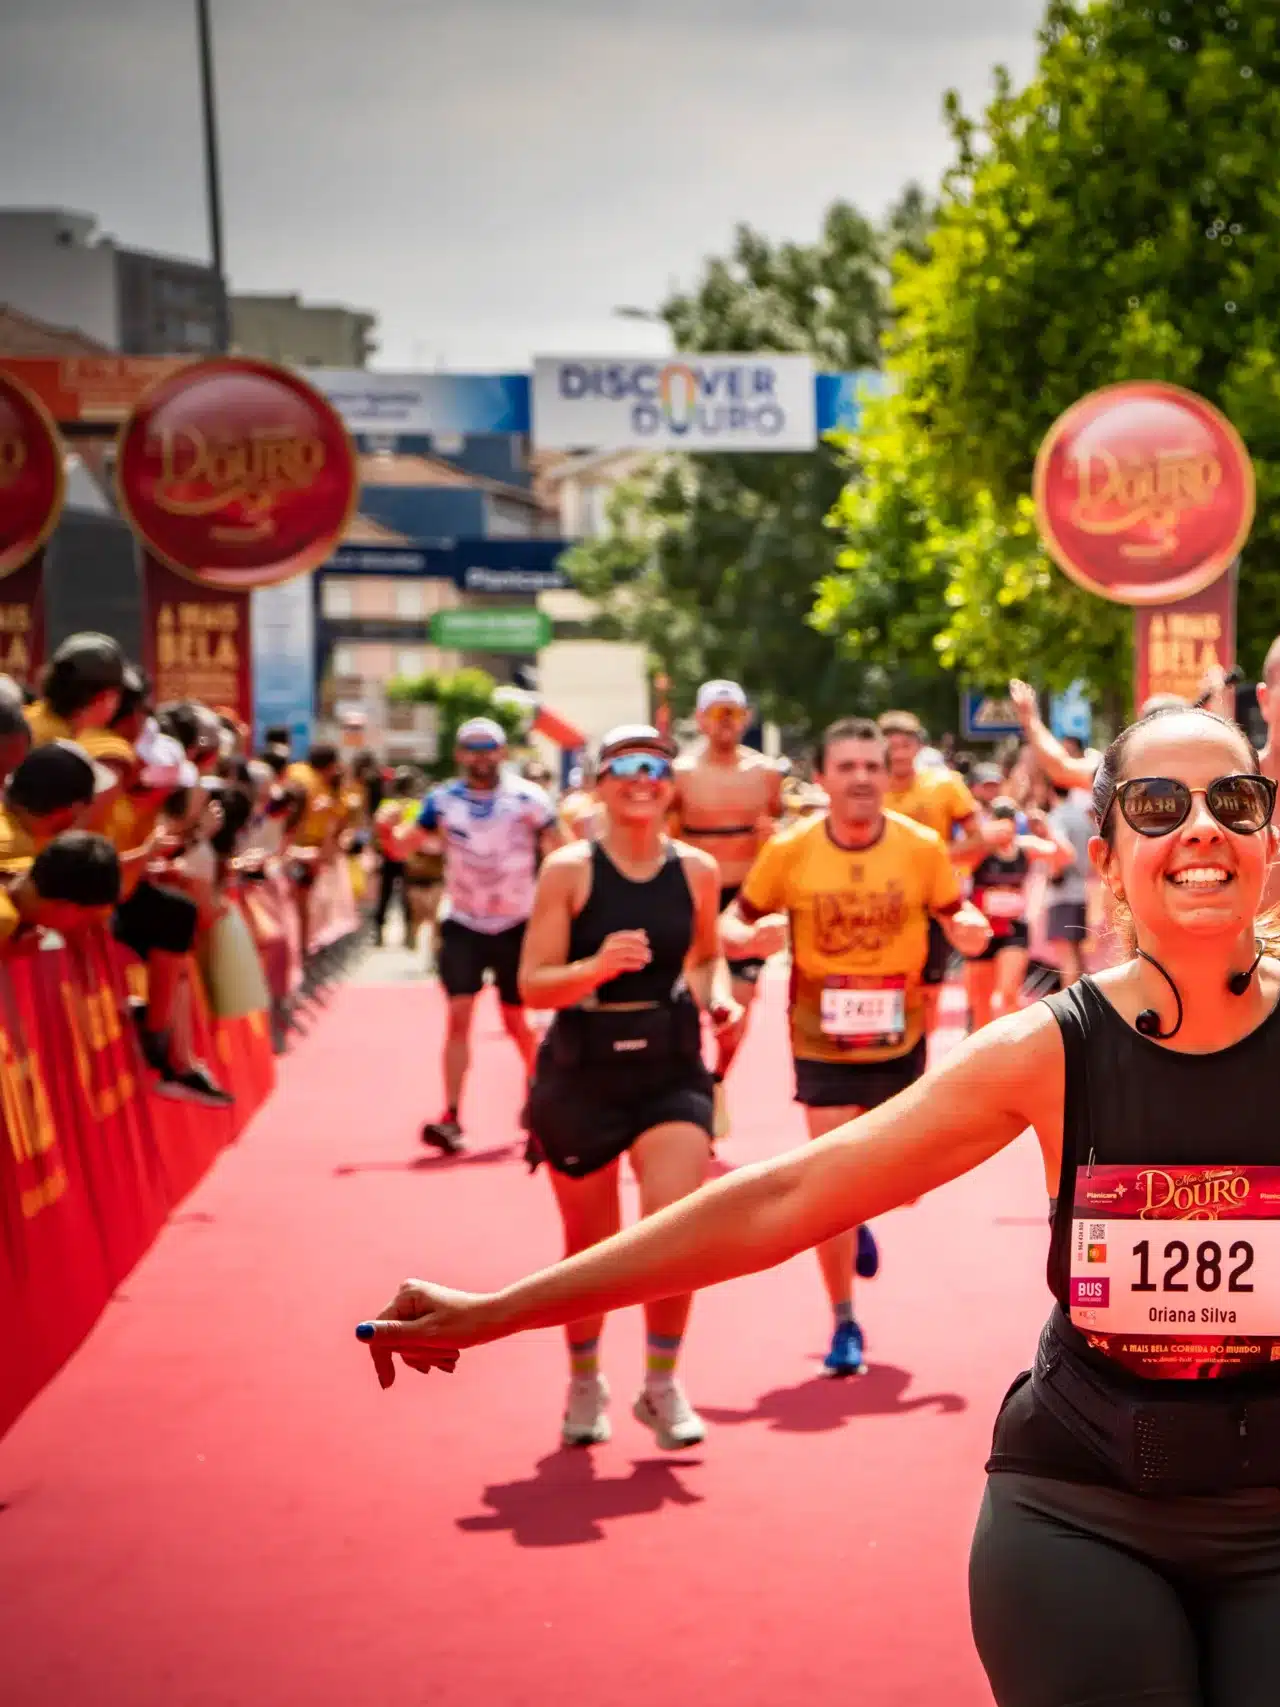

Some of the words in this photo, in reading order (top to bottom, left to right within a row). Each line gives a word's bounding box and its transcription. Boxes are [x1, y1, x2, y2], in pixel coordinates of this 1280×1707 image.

[559, 364, 778, 401] DISCOVER
[632, 404, 785, 436] DOURO
[148, 425, 326, 513] DOURO
[1072, 444, 1223, 533] DOURO
[1136, 1169, 1250, 1216] DOURO
[1130, 1239, 1255, 1293] 1282
[1077, 1282, 1103, 1297] BUS
[1149, 1307, 1196, 1323] Oriana
[1201, 1307, 1237, 1324] Silva
[1121, 1344, 1128, 1352] A
[1129, 1344, 1149, 1353] MAIS
[1150, 1344, 1169, 1353] BELA
[1170, 1344, 1208, 1353] CORRIDA
[1210, 1345, 1225, 1354] DO
